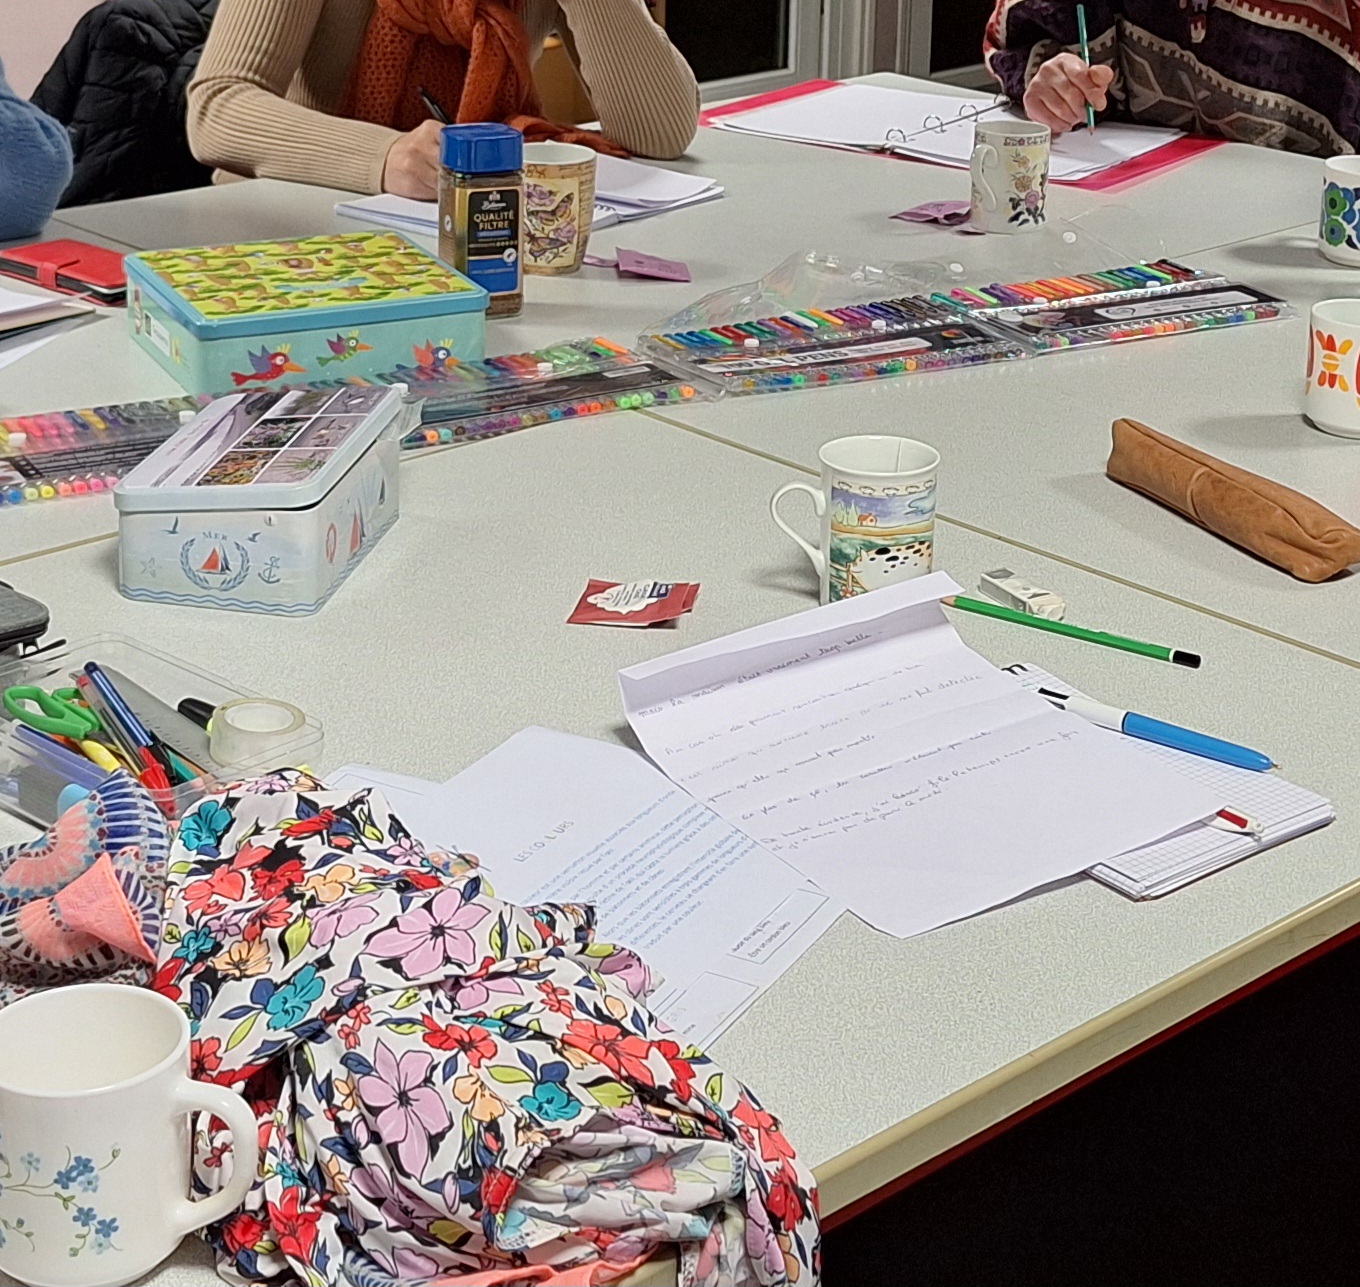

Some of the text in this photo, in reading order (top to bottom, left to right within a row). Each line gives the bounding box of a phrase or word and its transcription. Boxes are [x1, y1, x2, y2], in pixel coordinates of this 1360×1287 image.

[473, 209, 515, 223] QUALITÉ
[479, 221, 509, 230] FILTRE
[796, 350, 848, 363] PENS
[203, 531, 228, 541] MER
[737, 671, 762, 684] était
[766, 653, 811, 674] vraiment
[818, 644, 842, 657] trop
[513, 848, 534, 862] LES
